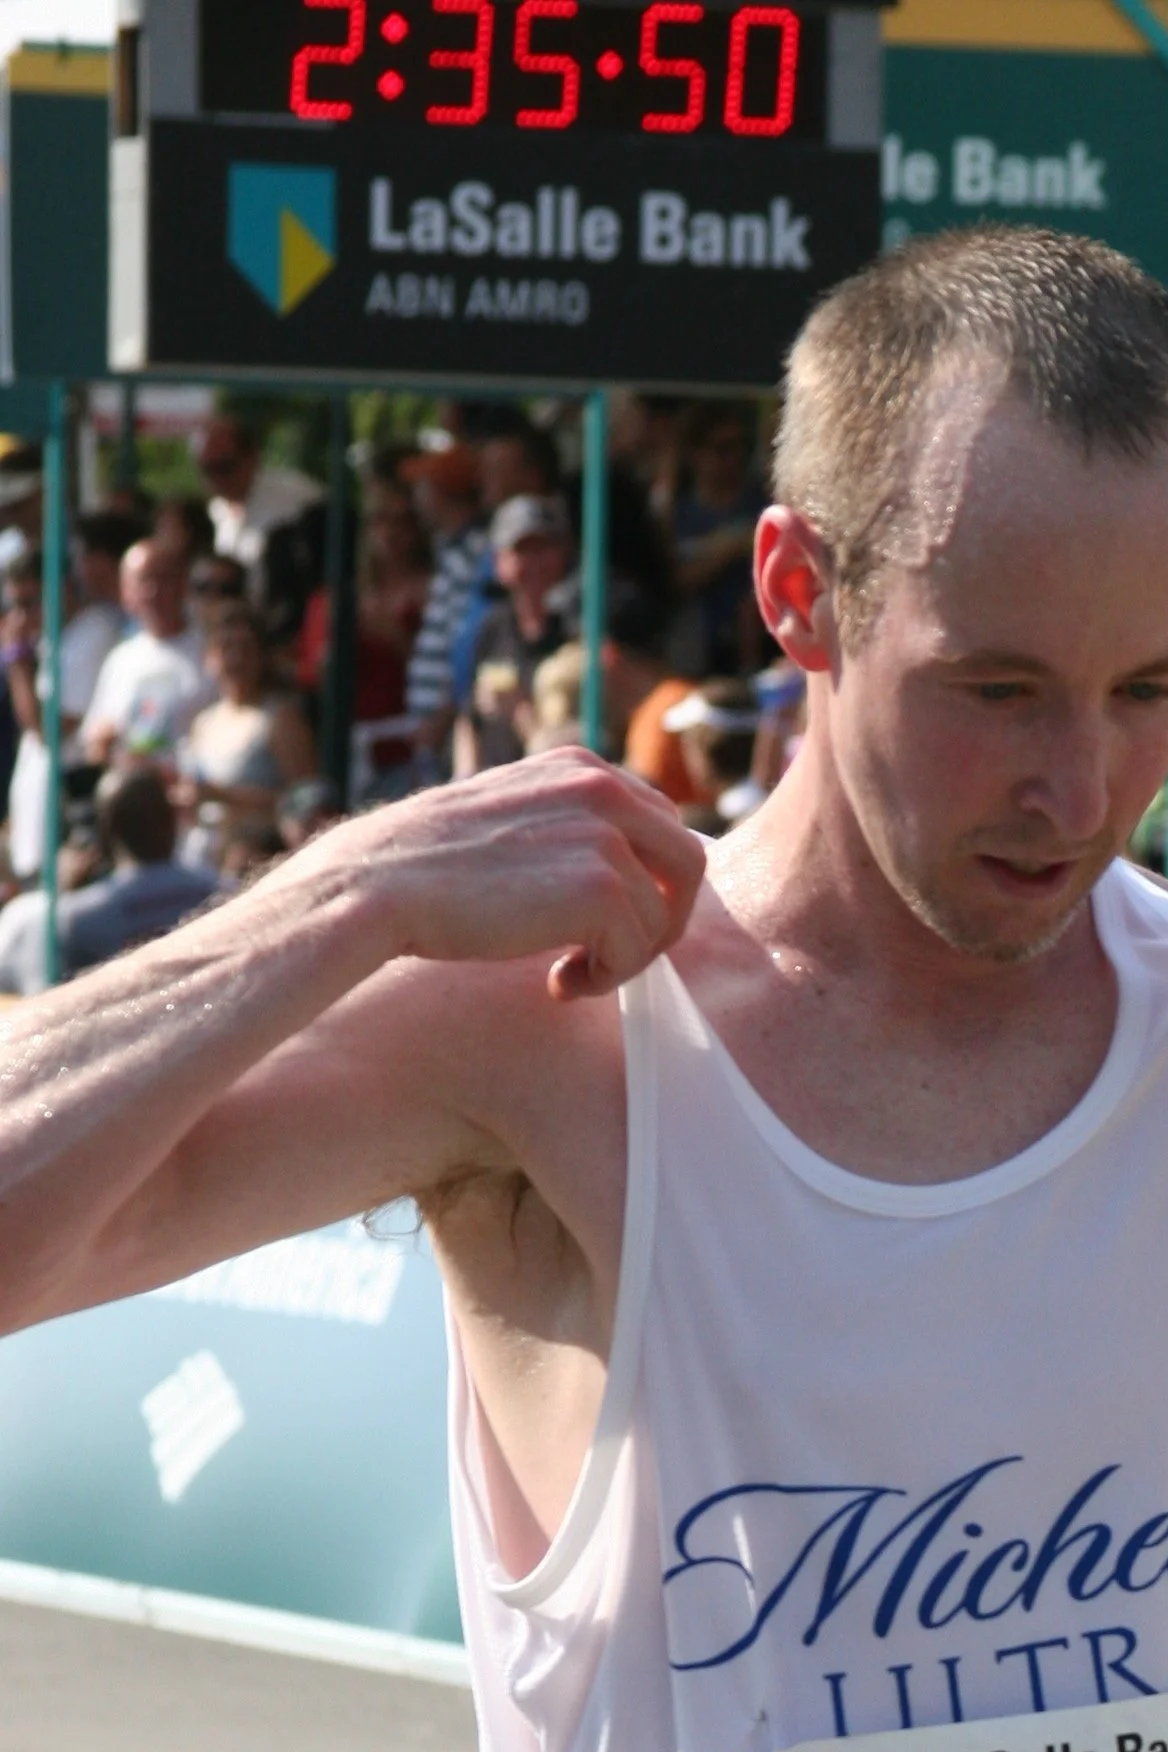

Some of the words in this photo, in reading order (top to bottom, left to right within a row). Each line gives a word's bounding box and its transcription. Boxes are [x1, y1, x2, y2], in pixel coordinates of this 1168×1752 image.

[951, 134, 1108, 210] Bank
[368, 176, 621, 262] LaSalle
[640, 190, 812, 270] Bank
[366, 273, 453, 318] ABN
[463, 277, 589, 325] AMRO
